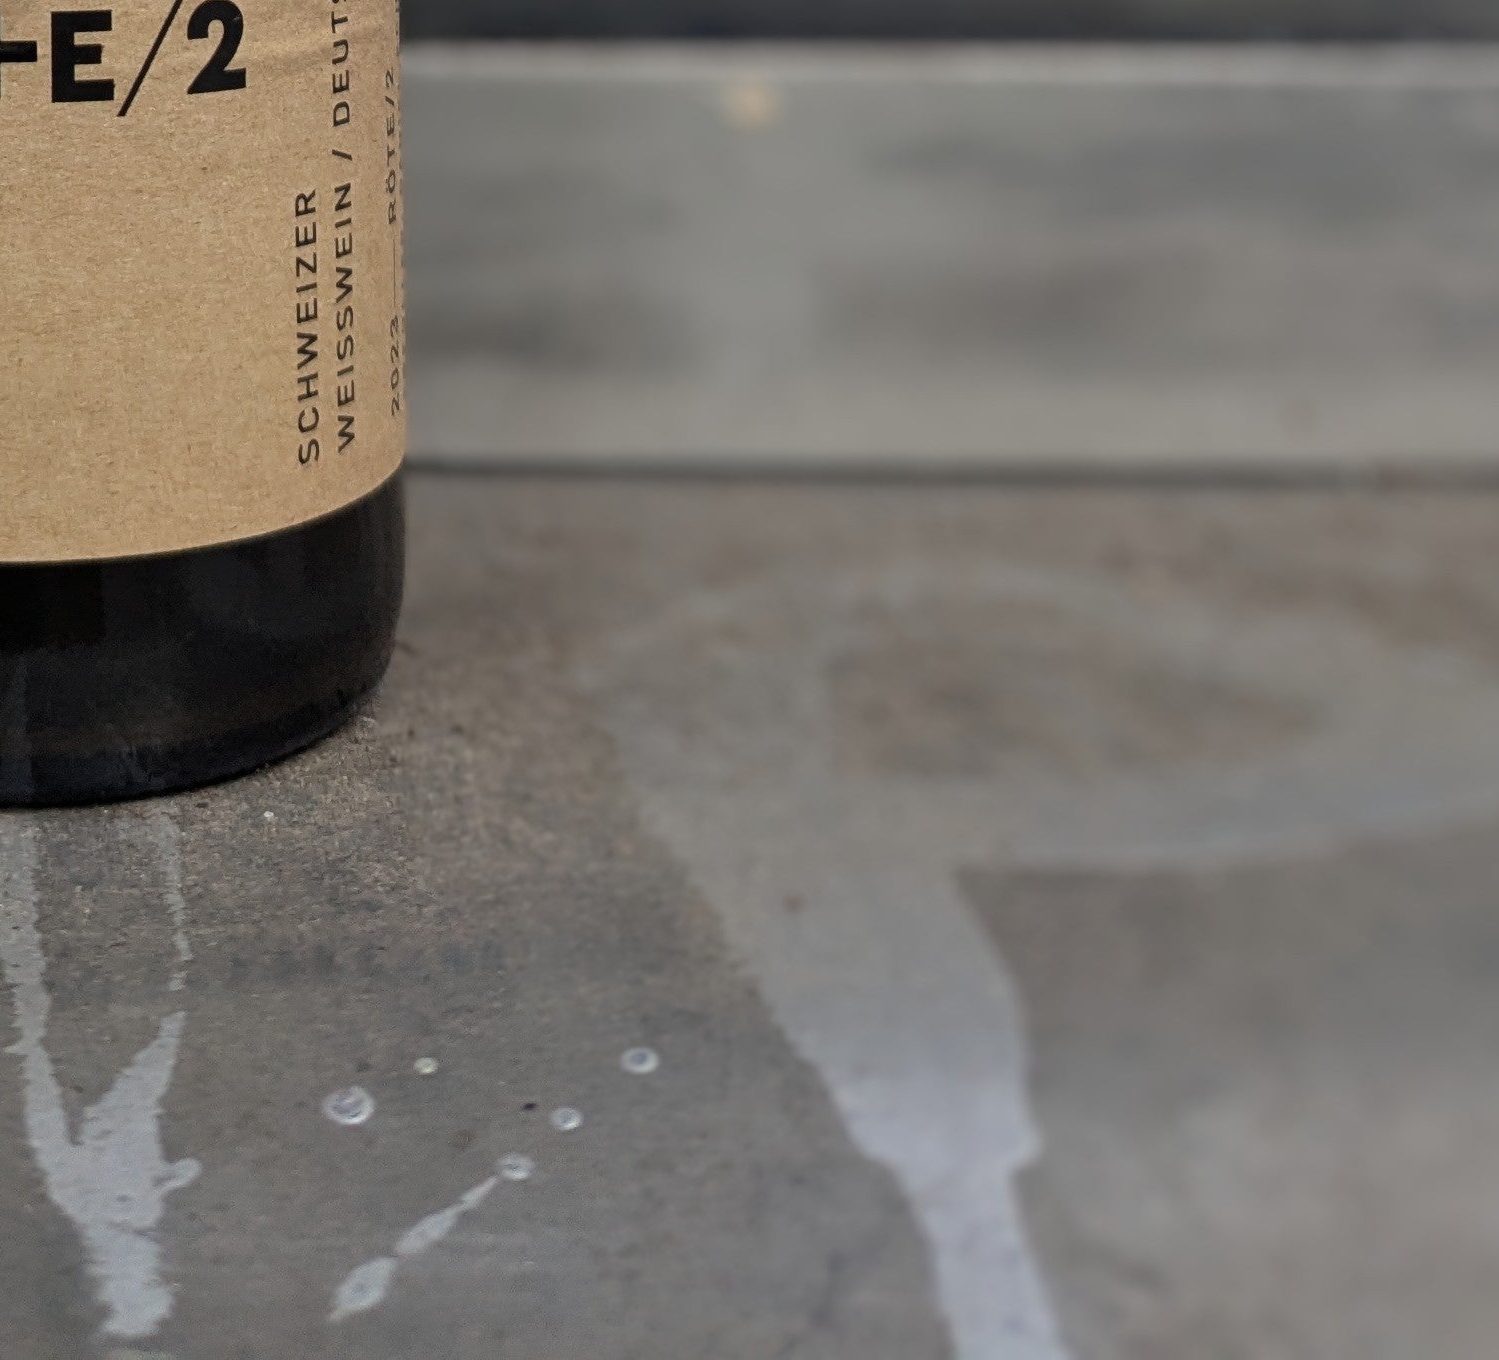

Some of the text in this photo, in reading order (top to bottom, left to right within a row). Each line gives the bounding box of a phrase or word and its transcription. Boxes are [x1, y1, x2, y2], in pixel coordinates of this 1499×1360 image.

[331, 148, 353, 161] /
[295, 188, 319, 465] SCHWEIZER
[333, 181, 355, 454] WEISSWEIN
[389, 314, 400, 417] 2023
